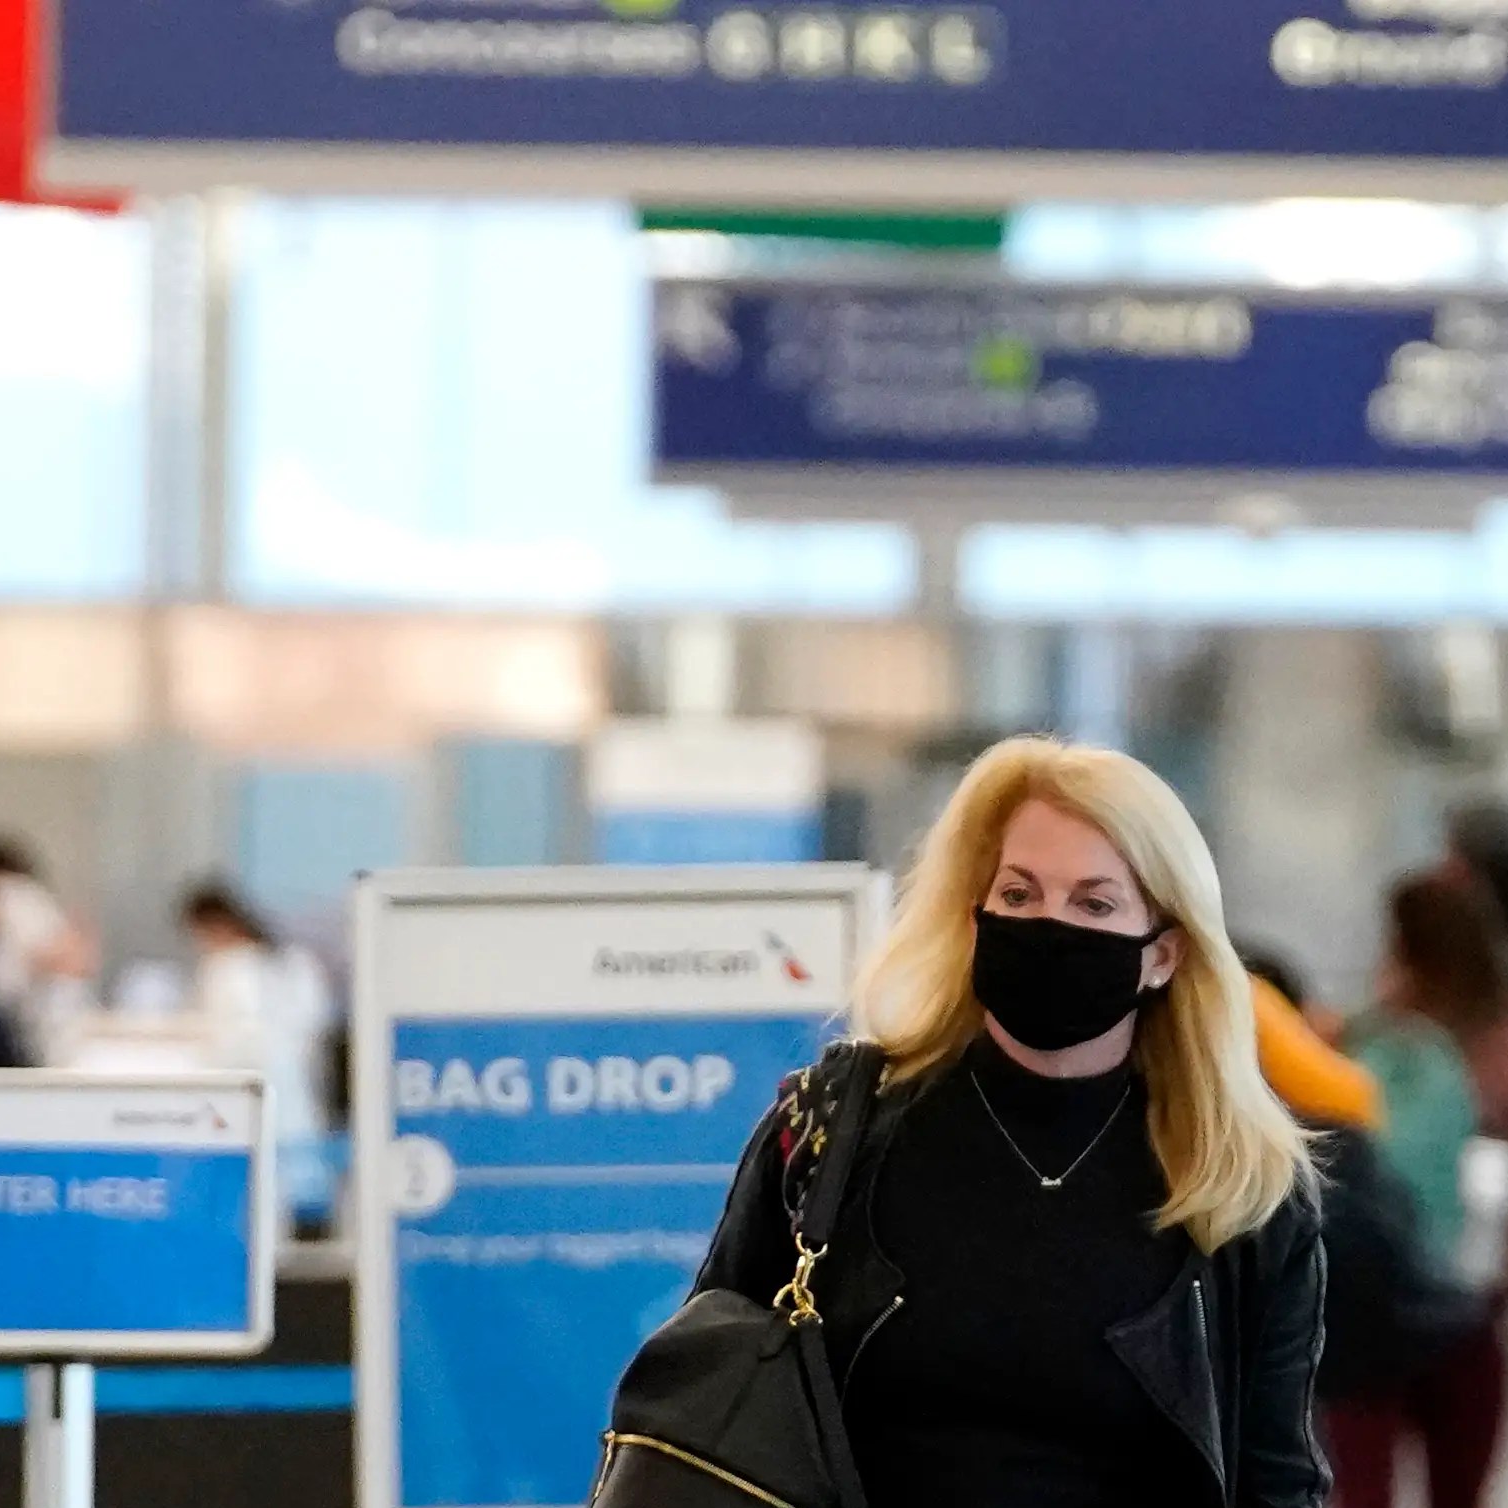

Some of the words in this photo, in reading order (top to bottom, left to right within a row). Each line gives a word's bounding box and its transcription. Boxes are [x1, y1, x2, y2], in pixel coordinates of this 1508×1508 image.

[395, 1057, 533, 1115] BAG
[547, 1054, 735, 1115] DROP
[65, 1176, 169, 1220] HERE
